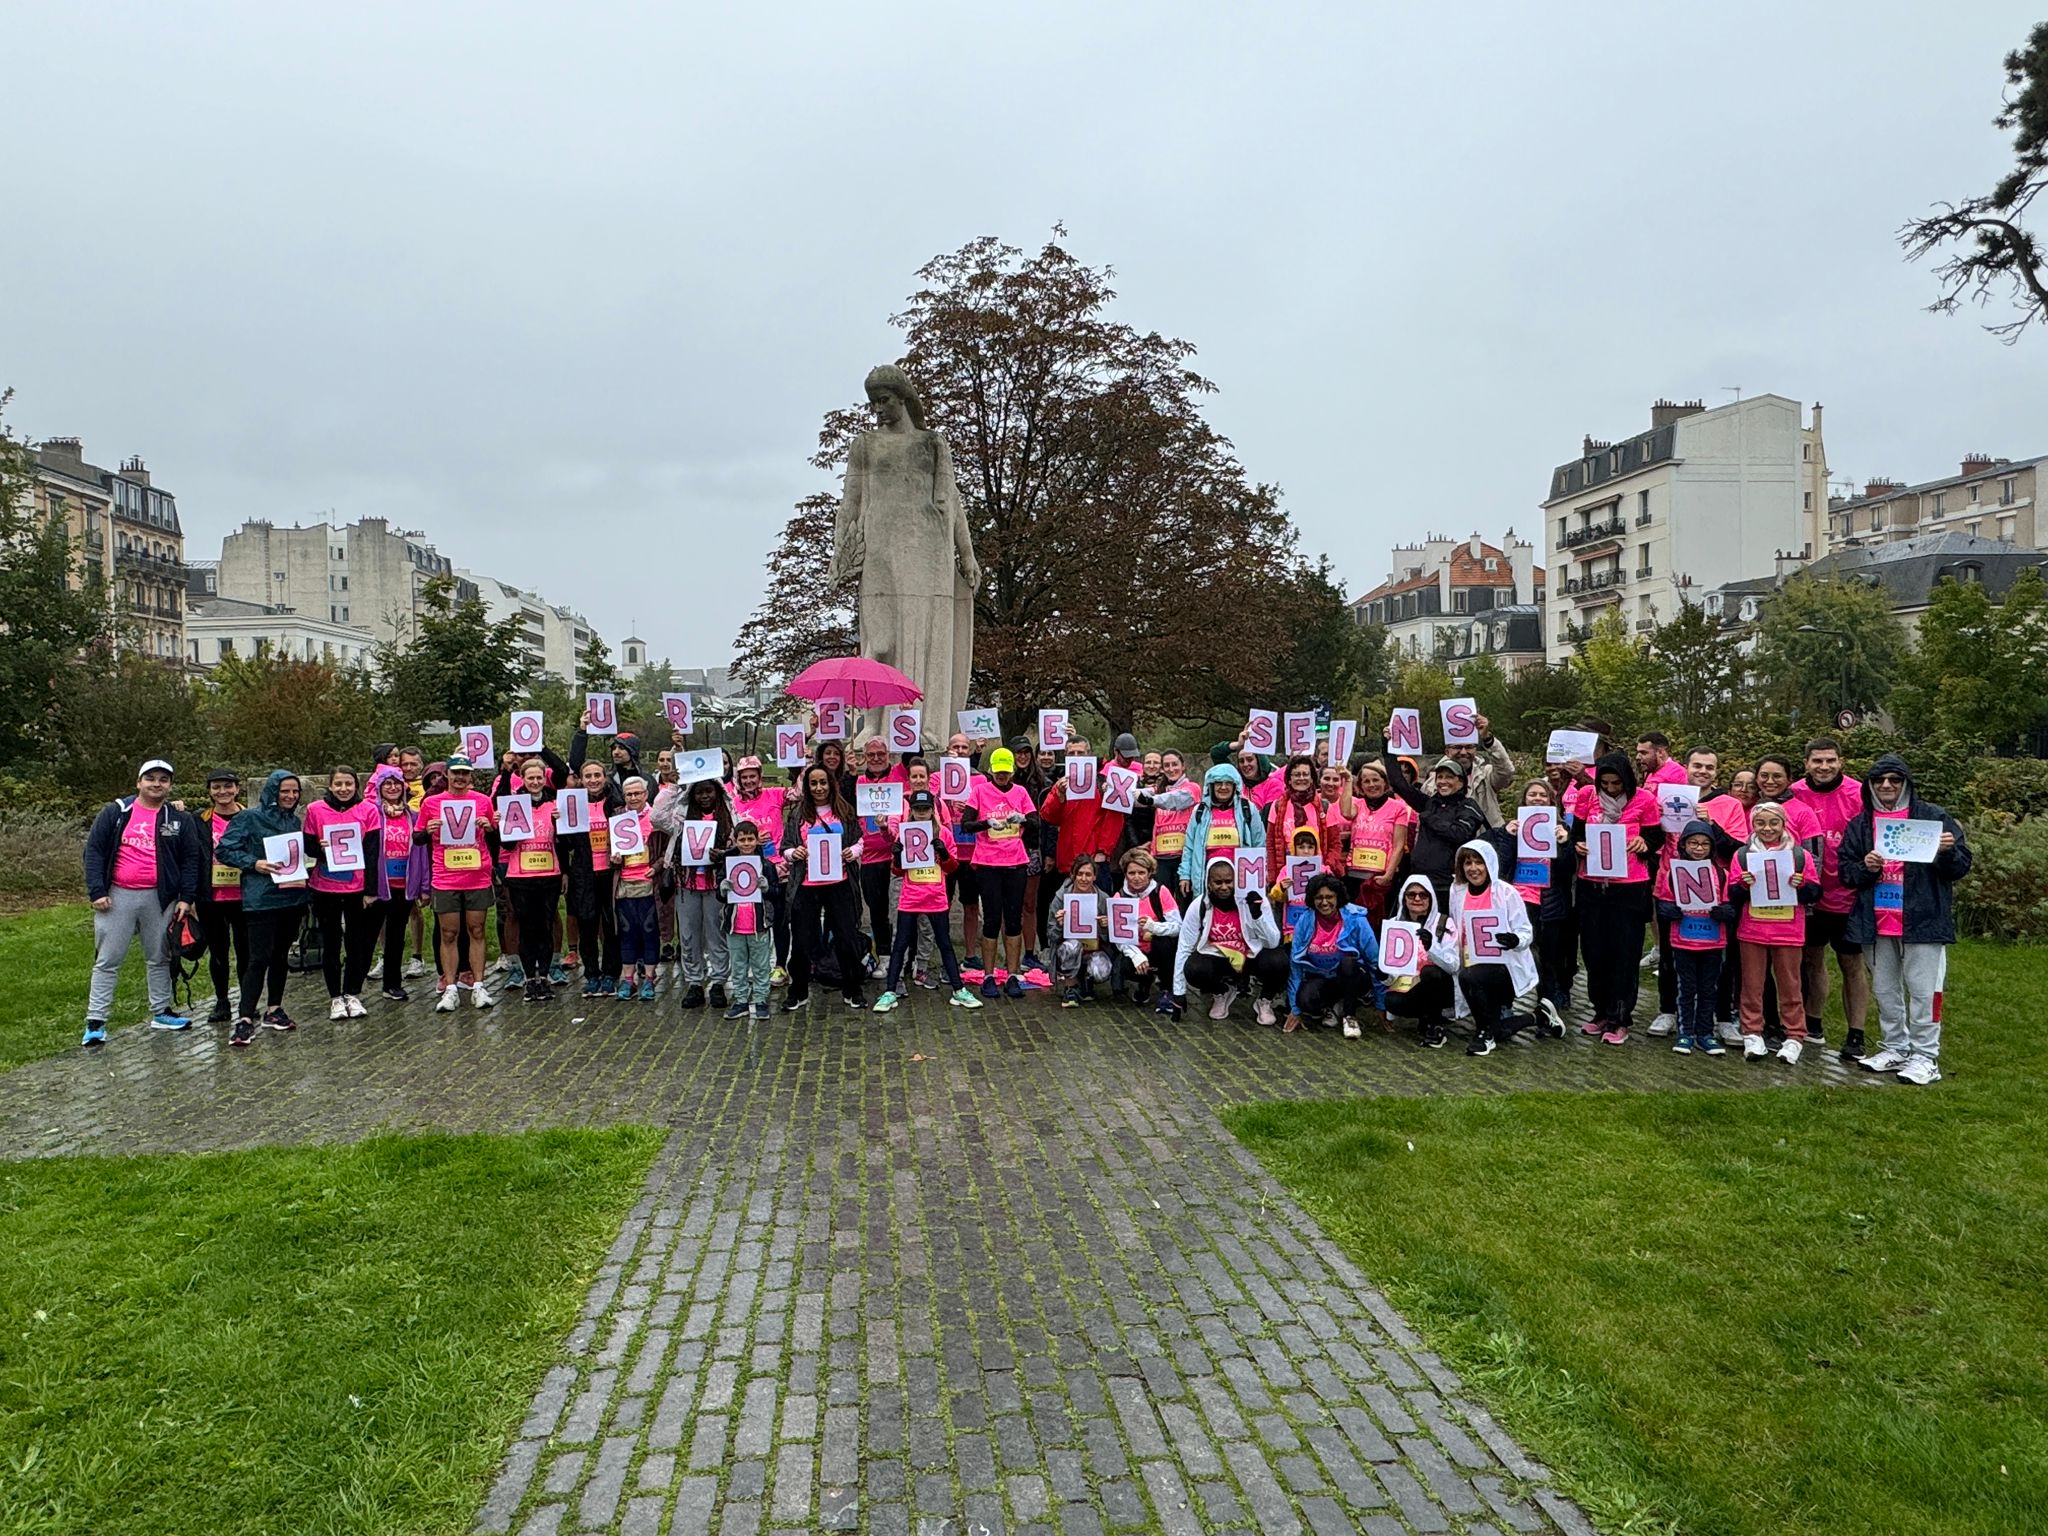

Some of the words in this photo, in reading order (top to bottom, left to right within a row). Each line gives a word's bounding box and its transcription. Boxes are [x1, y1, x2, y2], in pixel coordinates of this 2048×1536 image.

[590, 699, 612, 728] U
[667, 698, 688, 729] R
[819, 703, 840, 734] E
[1043, 714, 1064, 745] E
[1446, 705, 1474, 737] S
[513, 717, 539, 747] O
[779, 732, 804, 759] M
[893, 715, 916, 746] S
[1249, 716, 1273, 748] S
[1290, 718, 1310, 750] E
[1335, 727, 1345, 760] I
[1392, 715, 1419, 749] N
[466, 732, 489, 763] P
[944, 762, 967, 794] D
[1069, 763, 1093, 794] U
[1106, 772, 1134, 808] X
[503, 801, 531, 835] A
[566, 795, 578, 827] I
[870, 801, 890, 809] CPTS
[443, 806, 472, 840] V
[614, 818, 638, 850] S
[1522, 813, 1550, 851] C
[278, 839, 299, 875] J
[329, 829, 357, 865] E
[686, 826, 713, 860] V
[820, 839, 830, 875] I
[904, 828, 929, 863] R
[1600, 831, 1613, 870] I
[729, 862, 759, 896] O
[1238, 857, 1264, 889] M
[1676, 867, 1714, 904] N
[1070, 900, 1092, 933] L
[1113, 904, 1133, 938] E
[1384, 928, 1414, 967] D
[1472, 917, 1502, 956] E
